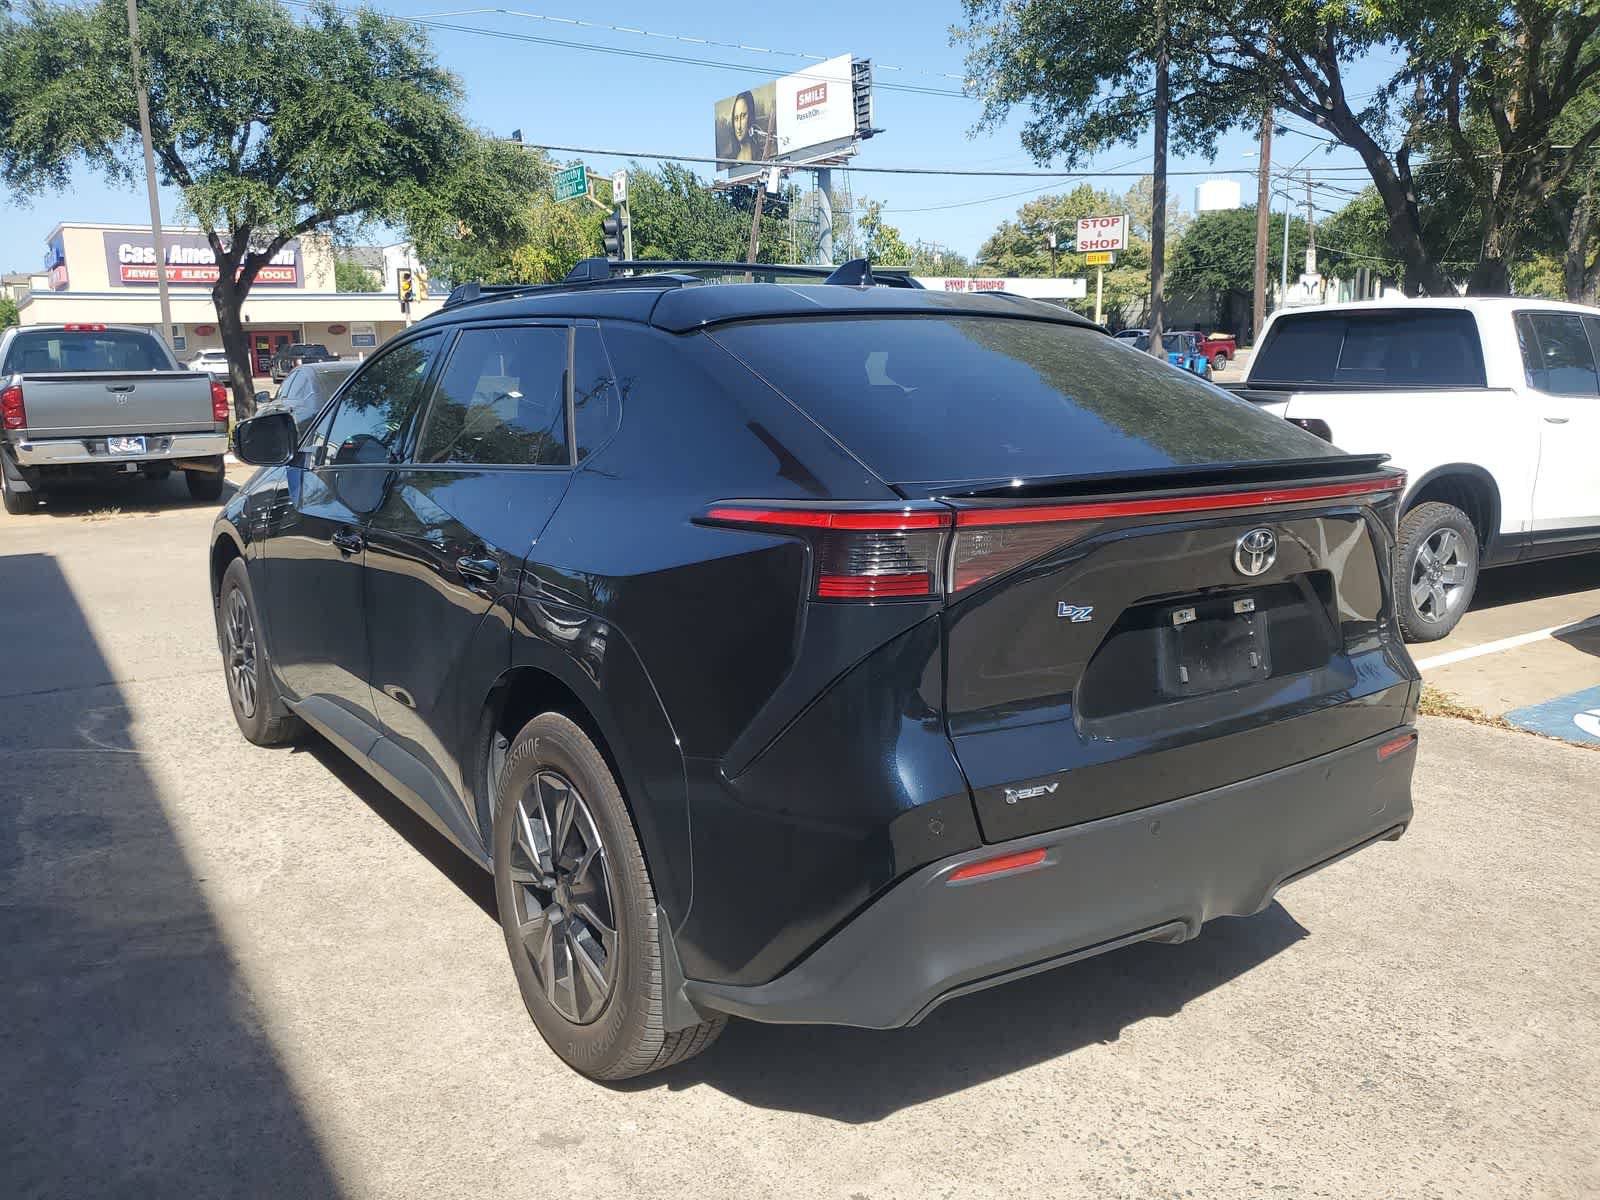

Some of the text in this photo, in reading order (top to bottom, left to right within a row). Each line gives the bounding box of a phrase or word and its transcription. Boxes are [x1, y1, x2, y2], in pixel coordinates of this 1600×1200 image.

[799, 87, 825, 105] SMILE
[1080, 217, 1120, 229] STOP
[1096, 230, 1103, 238] &
[1080, 239, 1120, 250] SHOP
[125, 270, 176, 280] JEWEY
[259, 271, 293, 280] TOOLS
